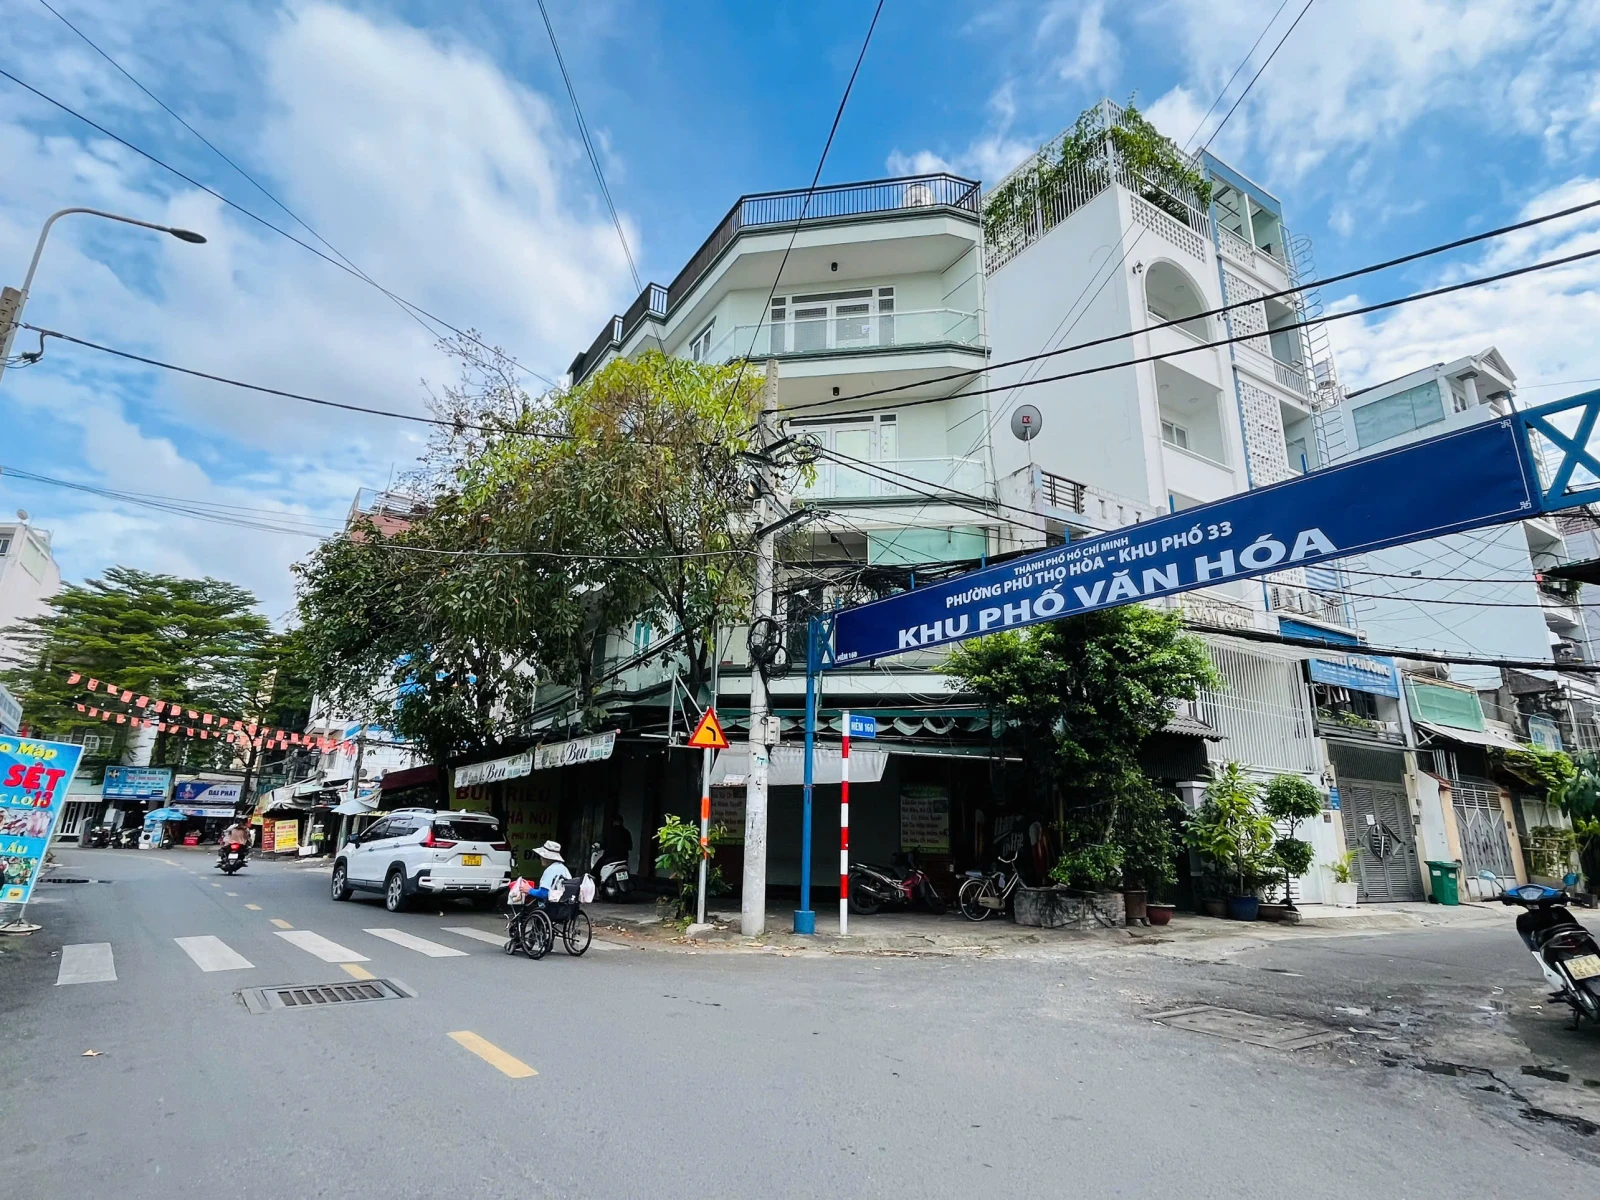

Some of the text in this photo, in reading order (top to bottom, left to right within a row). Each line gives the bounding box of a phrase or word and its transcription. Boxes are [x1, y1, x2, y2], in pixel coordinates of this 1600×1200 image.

[946, 583, 1001, 608] PHƯỜNG
[1004, 573, 1033, 594] PHÚ
[1035, 566, 1067, 585] THỌ
[1069, 556, 1105, 576] HÒA
[1118, 540, 1157, 563] KHU
[1161, 523, 1204, 552] PHỐ
[1207, 521, 1233, 540] 33
[1014, 537, 1129, 576] THÀNH PHỐ HỒ CHÍ MINH
[898, 614, 969, 650] KHU
[979, 583, 1065, 632] PHỐ
[1073, 562, 1180, 608] VĂN
[1195, 527, 1338, 582] HÓA
[851, 719, 874, 733] HẺM 160
[17, 742, 58, 760] Mập
[3, 762, 66, 794] SỆT
[33, 791, 53, 809] 13
